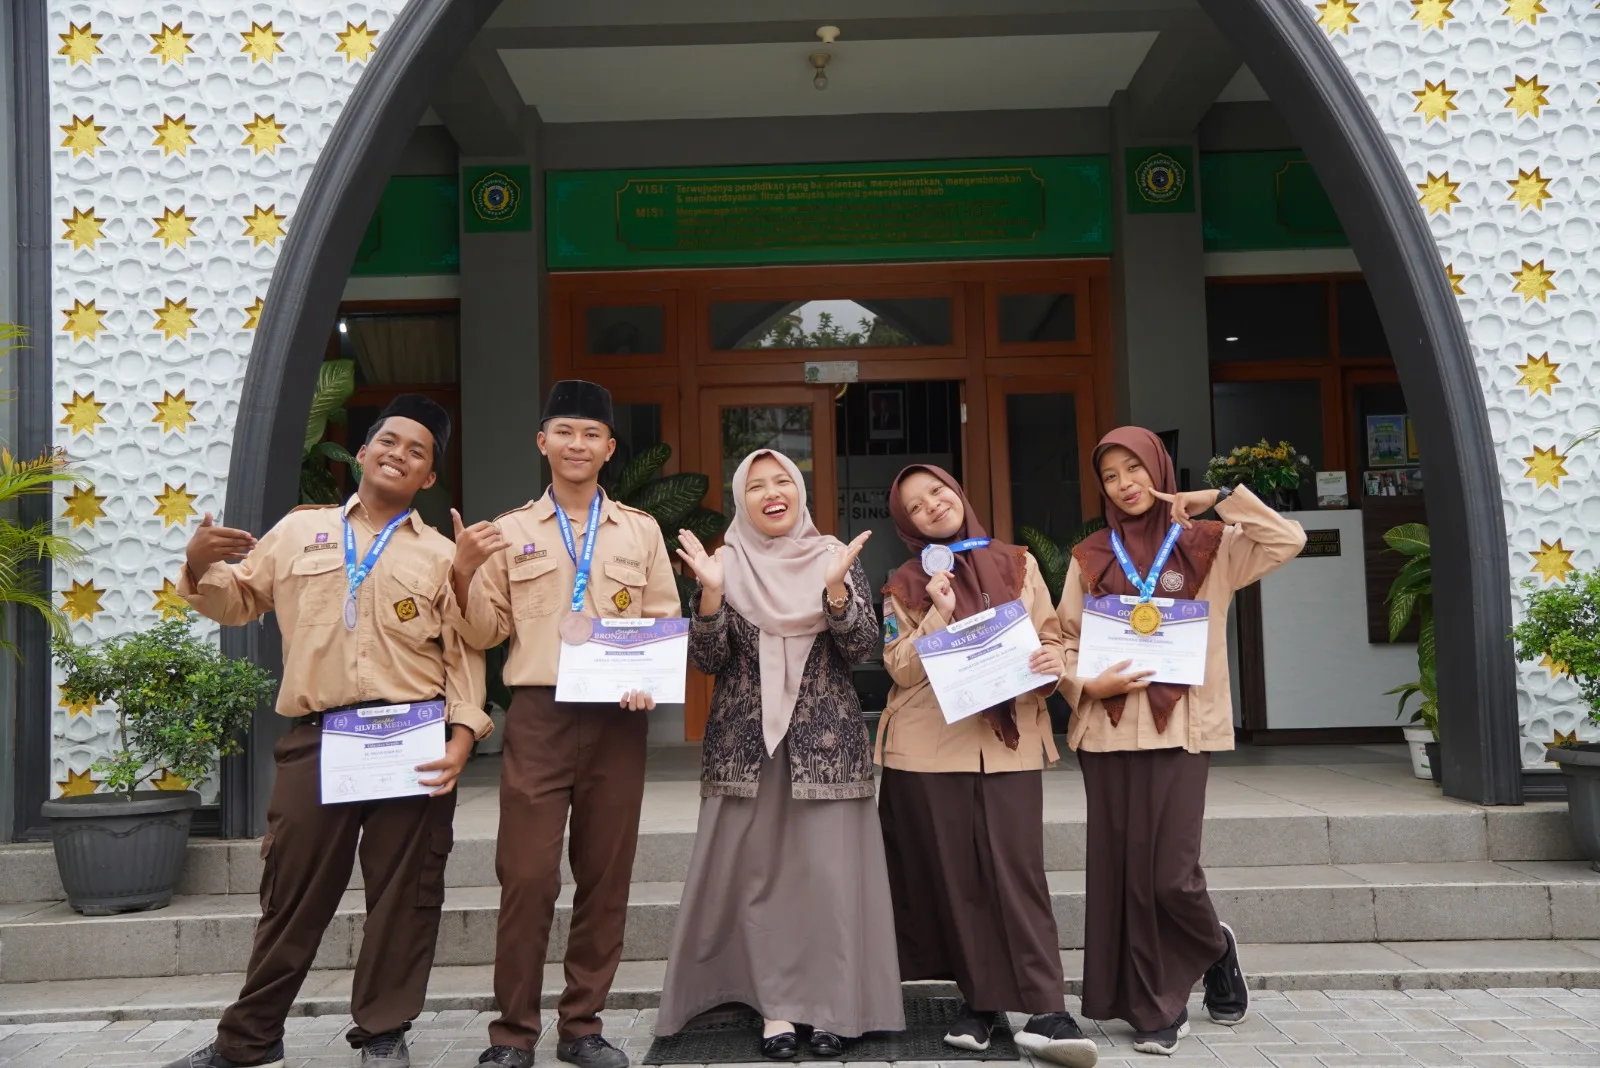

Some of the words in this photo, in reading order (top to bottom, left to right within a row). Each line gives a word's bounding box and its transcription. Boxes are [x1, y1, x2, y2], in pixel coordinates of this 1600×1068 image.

[676, 184, 733, 195] Terwujudnya
[735, 182, 786, 194] pendidikan
[787, 182, 808, 193] yang
[852, 507, 890, 520] SING
[594, 632, 628, 640] BRONZE
[950, 632, 978, 648] SILVER
[978, 622, 1004, 637] MEDAL
[354, 723, 382, 732] SILVER
[384, 719, 413, 730] MEDAL
